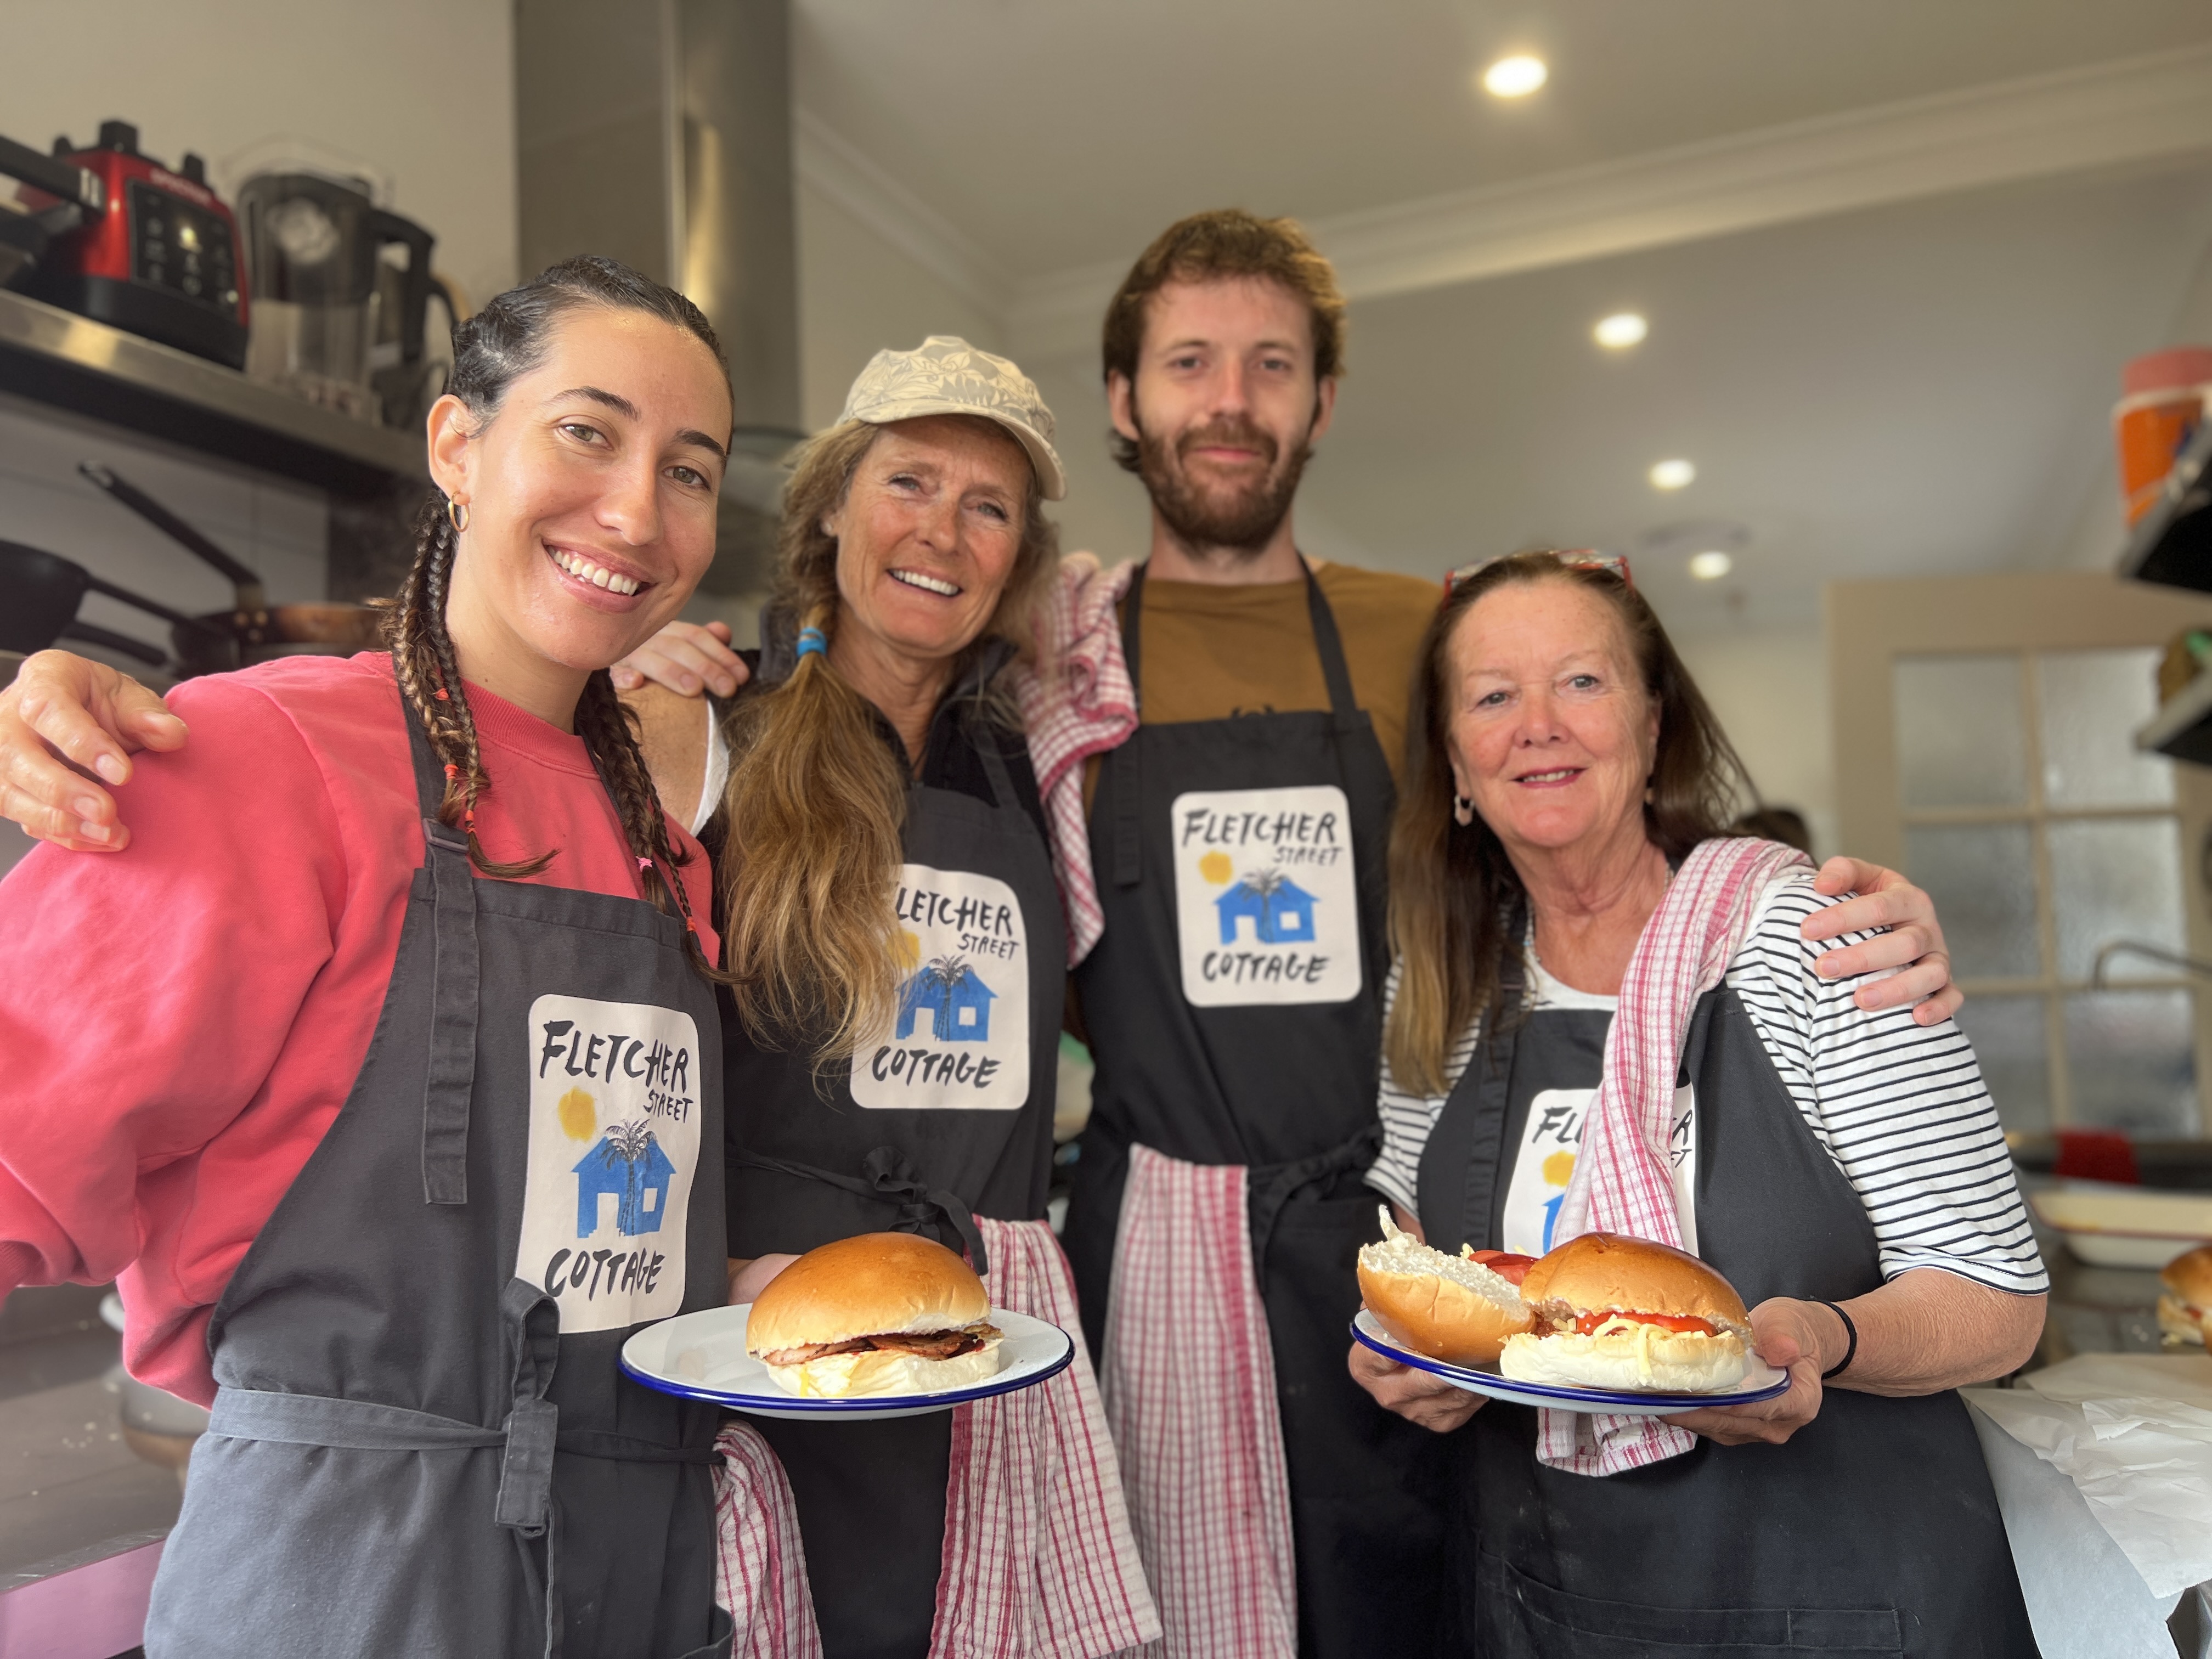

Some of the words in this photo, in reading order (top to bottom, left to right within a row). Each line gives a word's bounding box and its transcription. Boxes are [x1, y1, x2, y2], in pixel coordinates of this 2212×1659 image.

[1182, 808, 1337, 848] FLETCHER
[1273, 846, 1343, 866] STREET
[895, 882, 1013, 937] LETCHER
[957, 933, 1020, 961] STREET
[1202, 951, 1330, 985] COTTAGE
[539, 1020, 689, 1093] FLETCHER
[872, 1046, 1002, 1088] COTTAGE
[643, 1088, 695, 1124] STREET
[545, 1248, 666, 1301] COTTAGE
